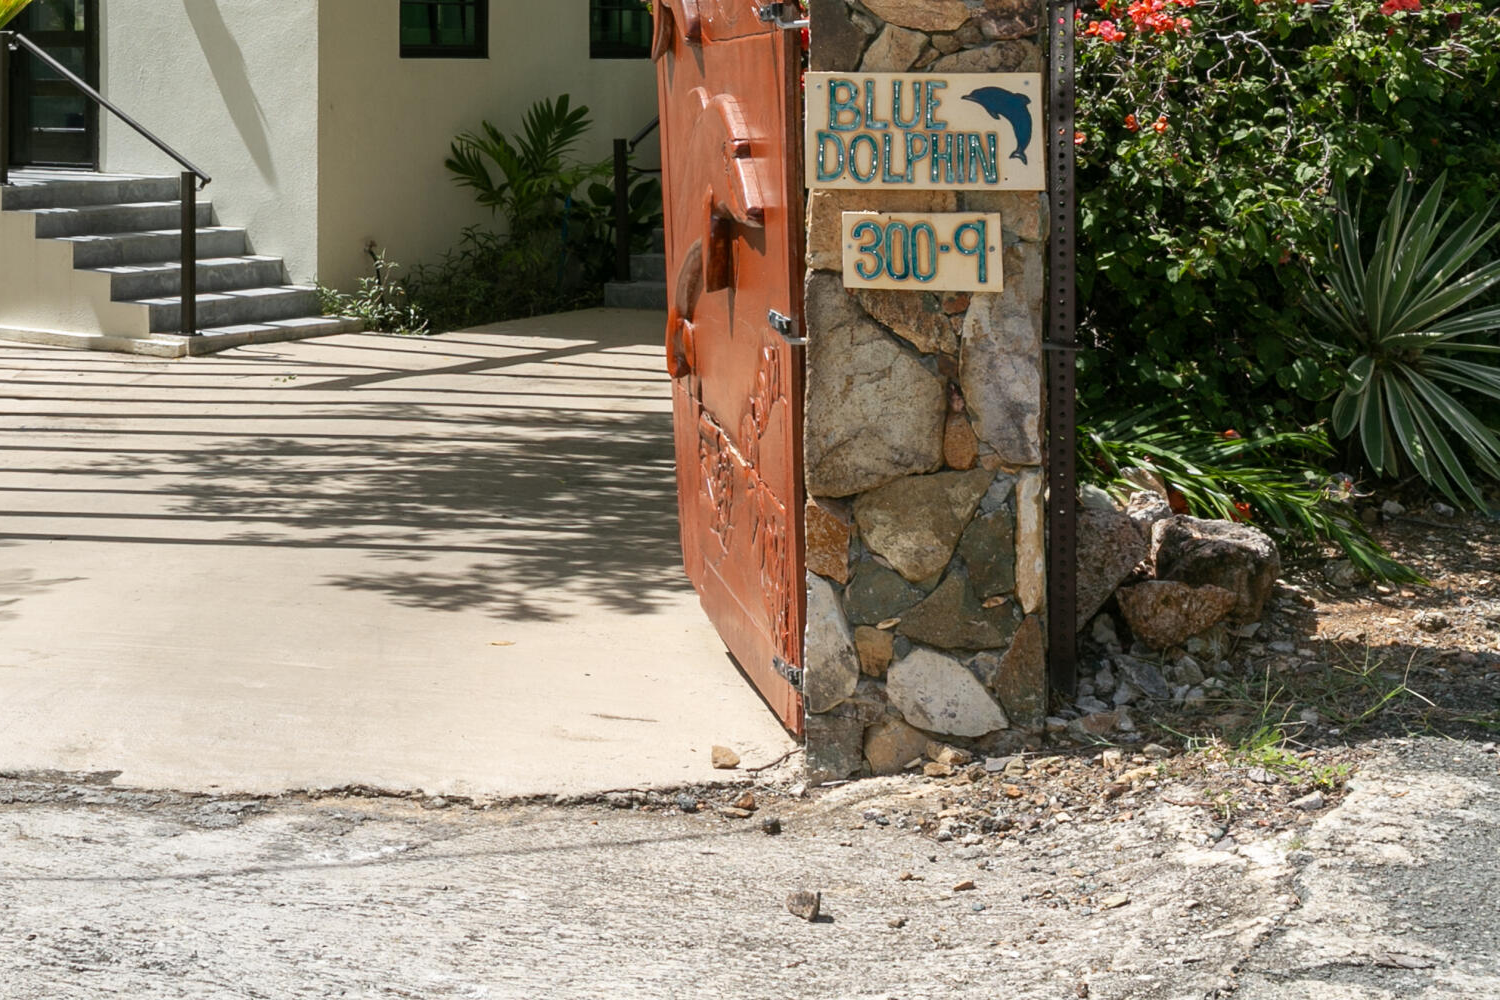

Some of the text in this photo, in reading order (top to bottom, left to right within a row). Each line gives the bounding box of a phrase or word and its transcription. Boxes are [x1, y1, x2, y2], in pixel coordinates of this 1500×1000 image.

[828, 79, 948, 131] BLUE
[816, 131, 998, 184] DOLPHIN
[852, 219, 988, 284] 300-9
